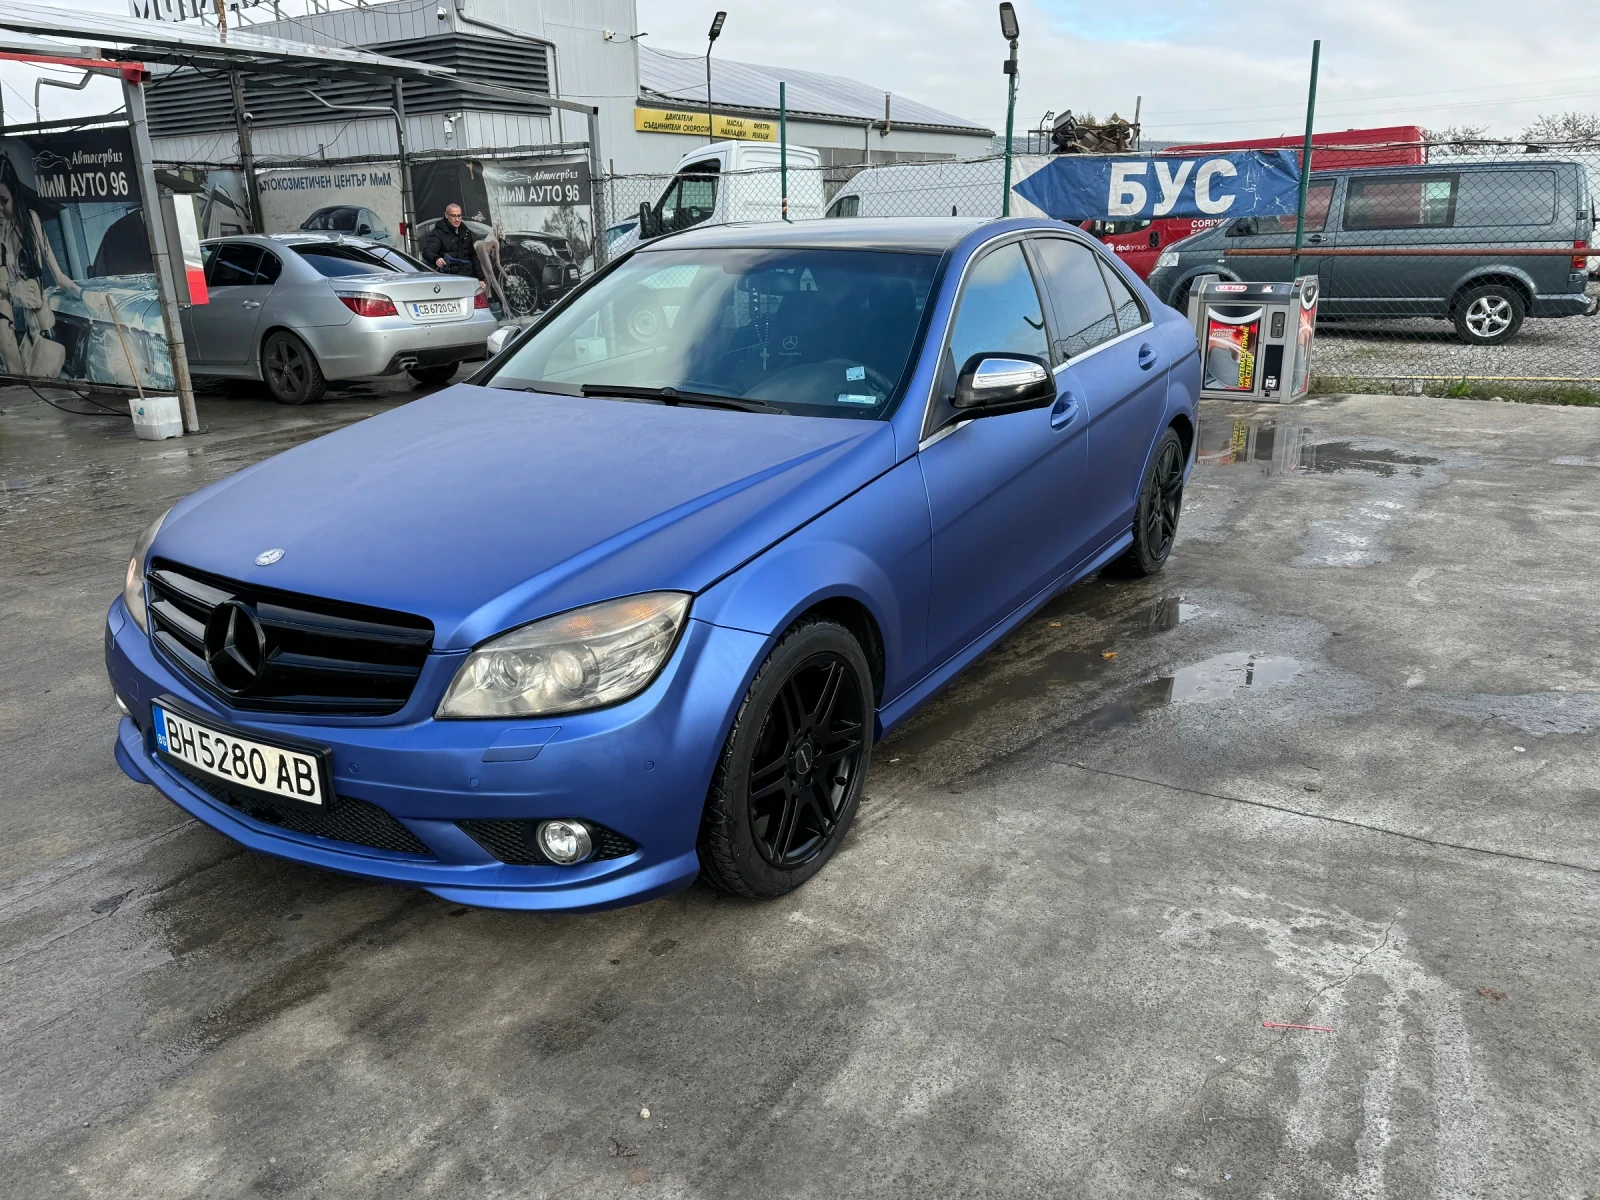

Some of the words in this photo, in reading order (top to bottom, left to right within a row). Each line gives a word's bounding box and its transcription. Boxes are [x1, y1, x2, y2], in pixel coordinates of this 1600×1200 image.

[664, 112, 694, 122] ДВИГАТЕЛИ
[726, 119, 743, 128] МАСЛА
[643, 121, 682, 131] СЪЕДИНИТЕЛИ
[720, 128, 747, 138] НАКЛАДКИ
[72, 148, 123, 168] Автосервиз
[334, 173, 367, 190] ЦЕНТЪР
[369, 172, 392, 187] МиМ
[532, 168, 578, 183] Автосервиз
[35, 174, 67, 198] МиМ
[70, 172, 108, 197] АУТО
[110, 171, 129, 196] 96
[1107, 158, 1238, 216] БУС
[498, 186, 525, 202] МиМ
[528, 184, 563, 202] АУТО
[565, 184, 580, 202] 96
[158, 733, 167, 747] BG
[277, 753, 316, 797] AB
